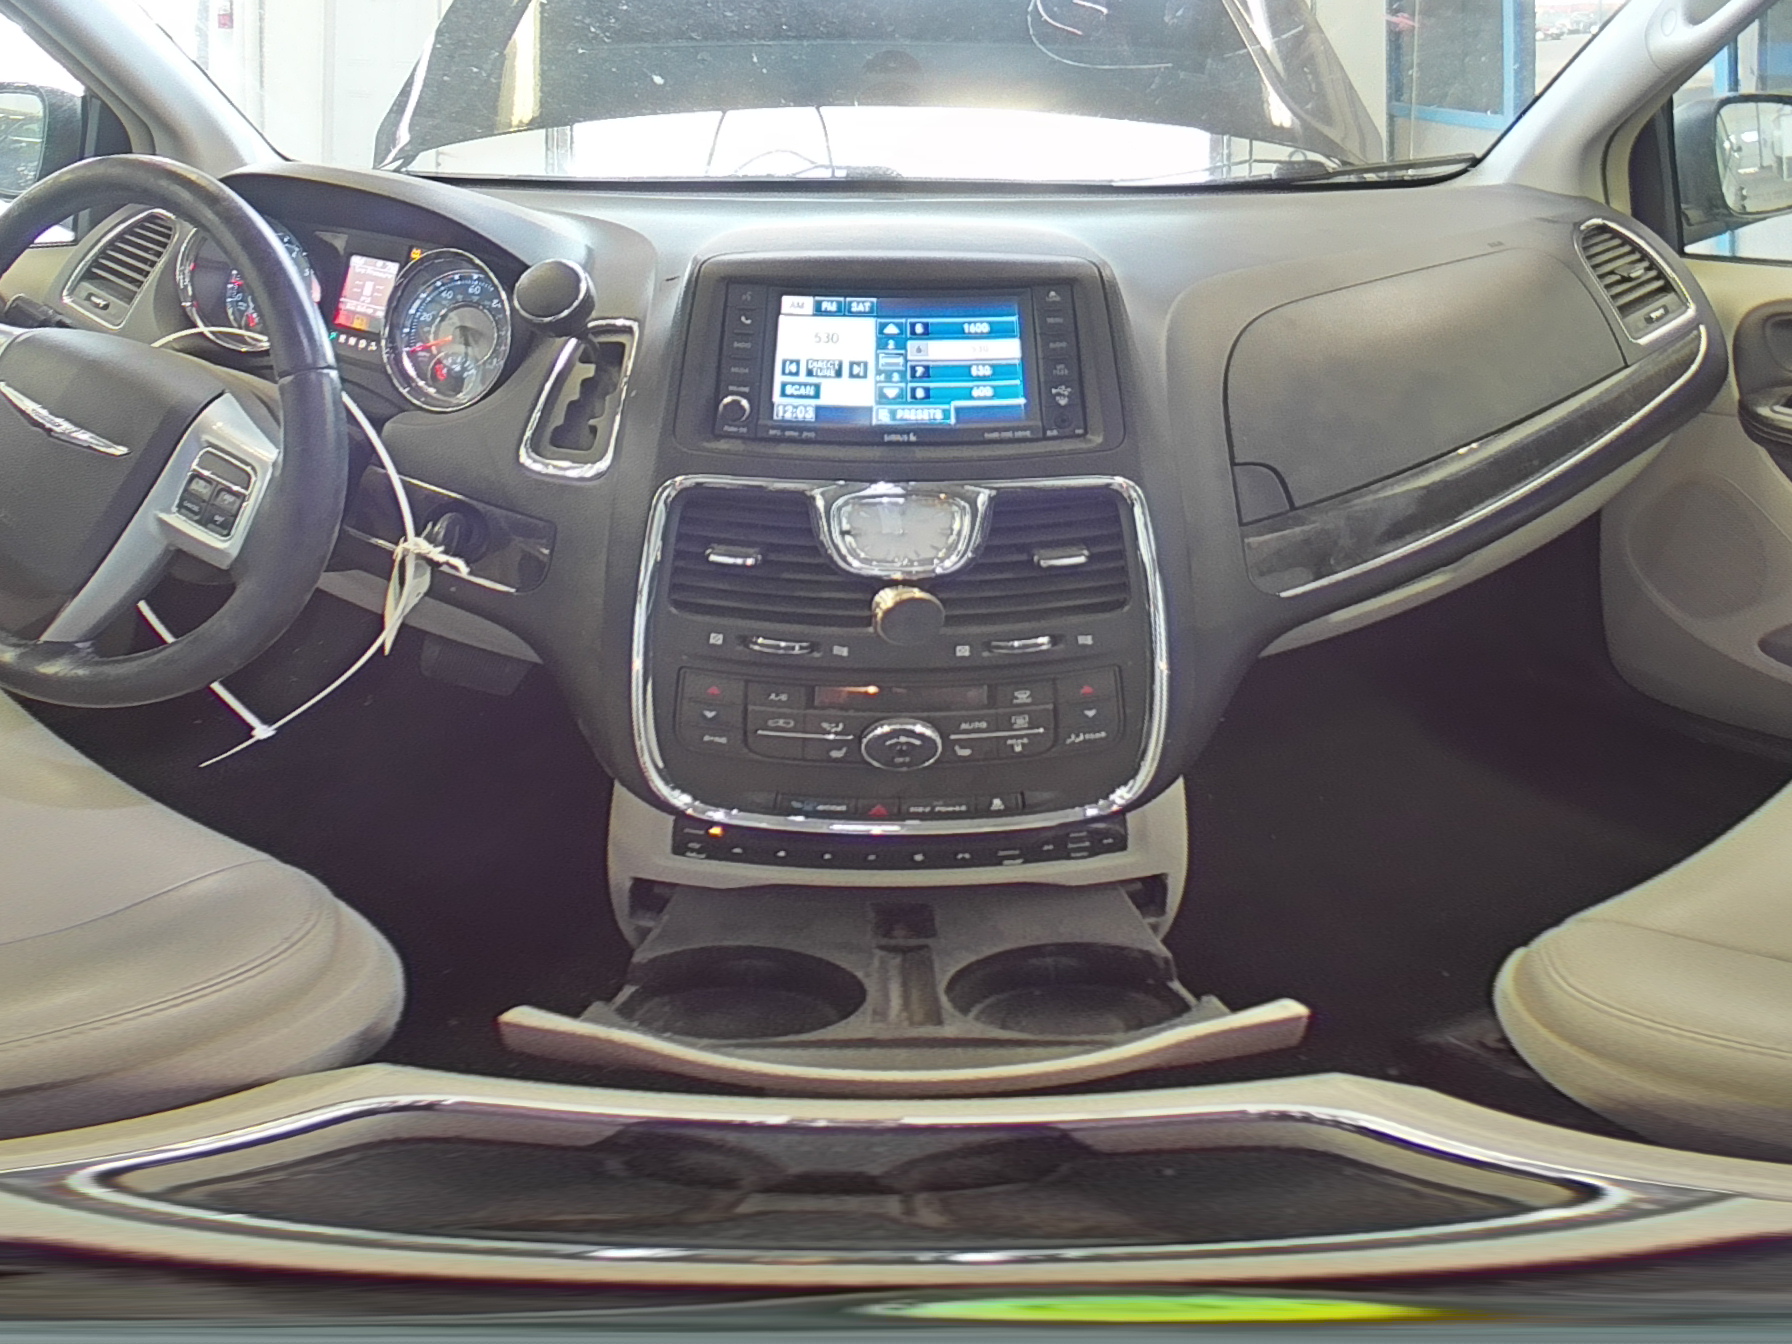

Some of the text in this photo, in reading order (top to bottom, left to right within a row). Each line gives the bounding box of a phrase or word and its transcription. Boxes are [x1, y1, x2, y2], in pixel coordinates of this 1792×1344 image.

[851, 301, 872, 312] SAT
[814, 332, 839, 344] 530
[785, 385, 816, 396] SCAN
